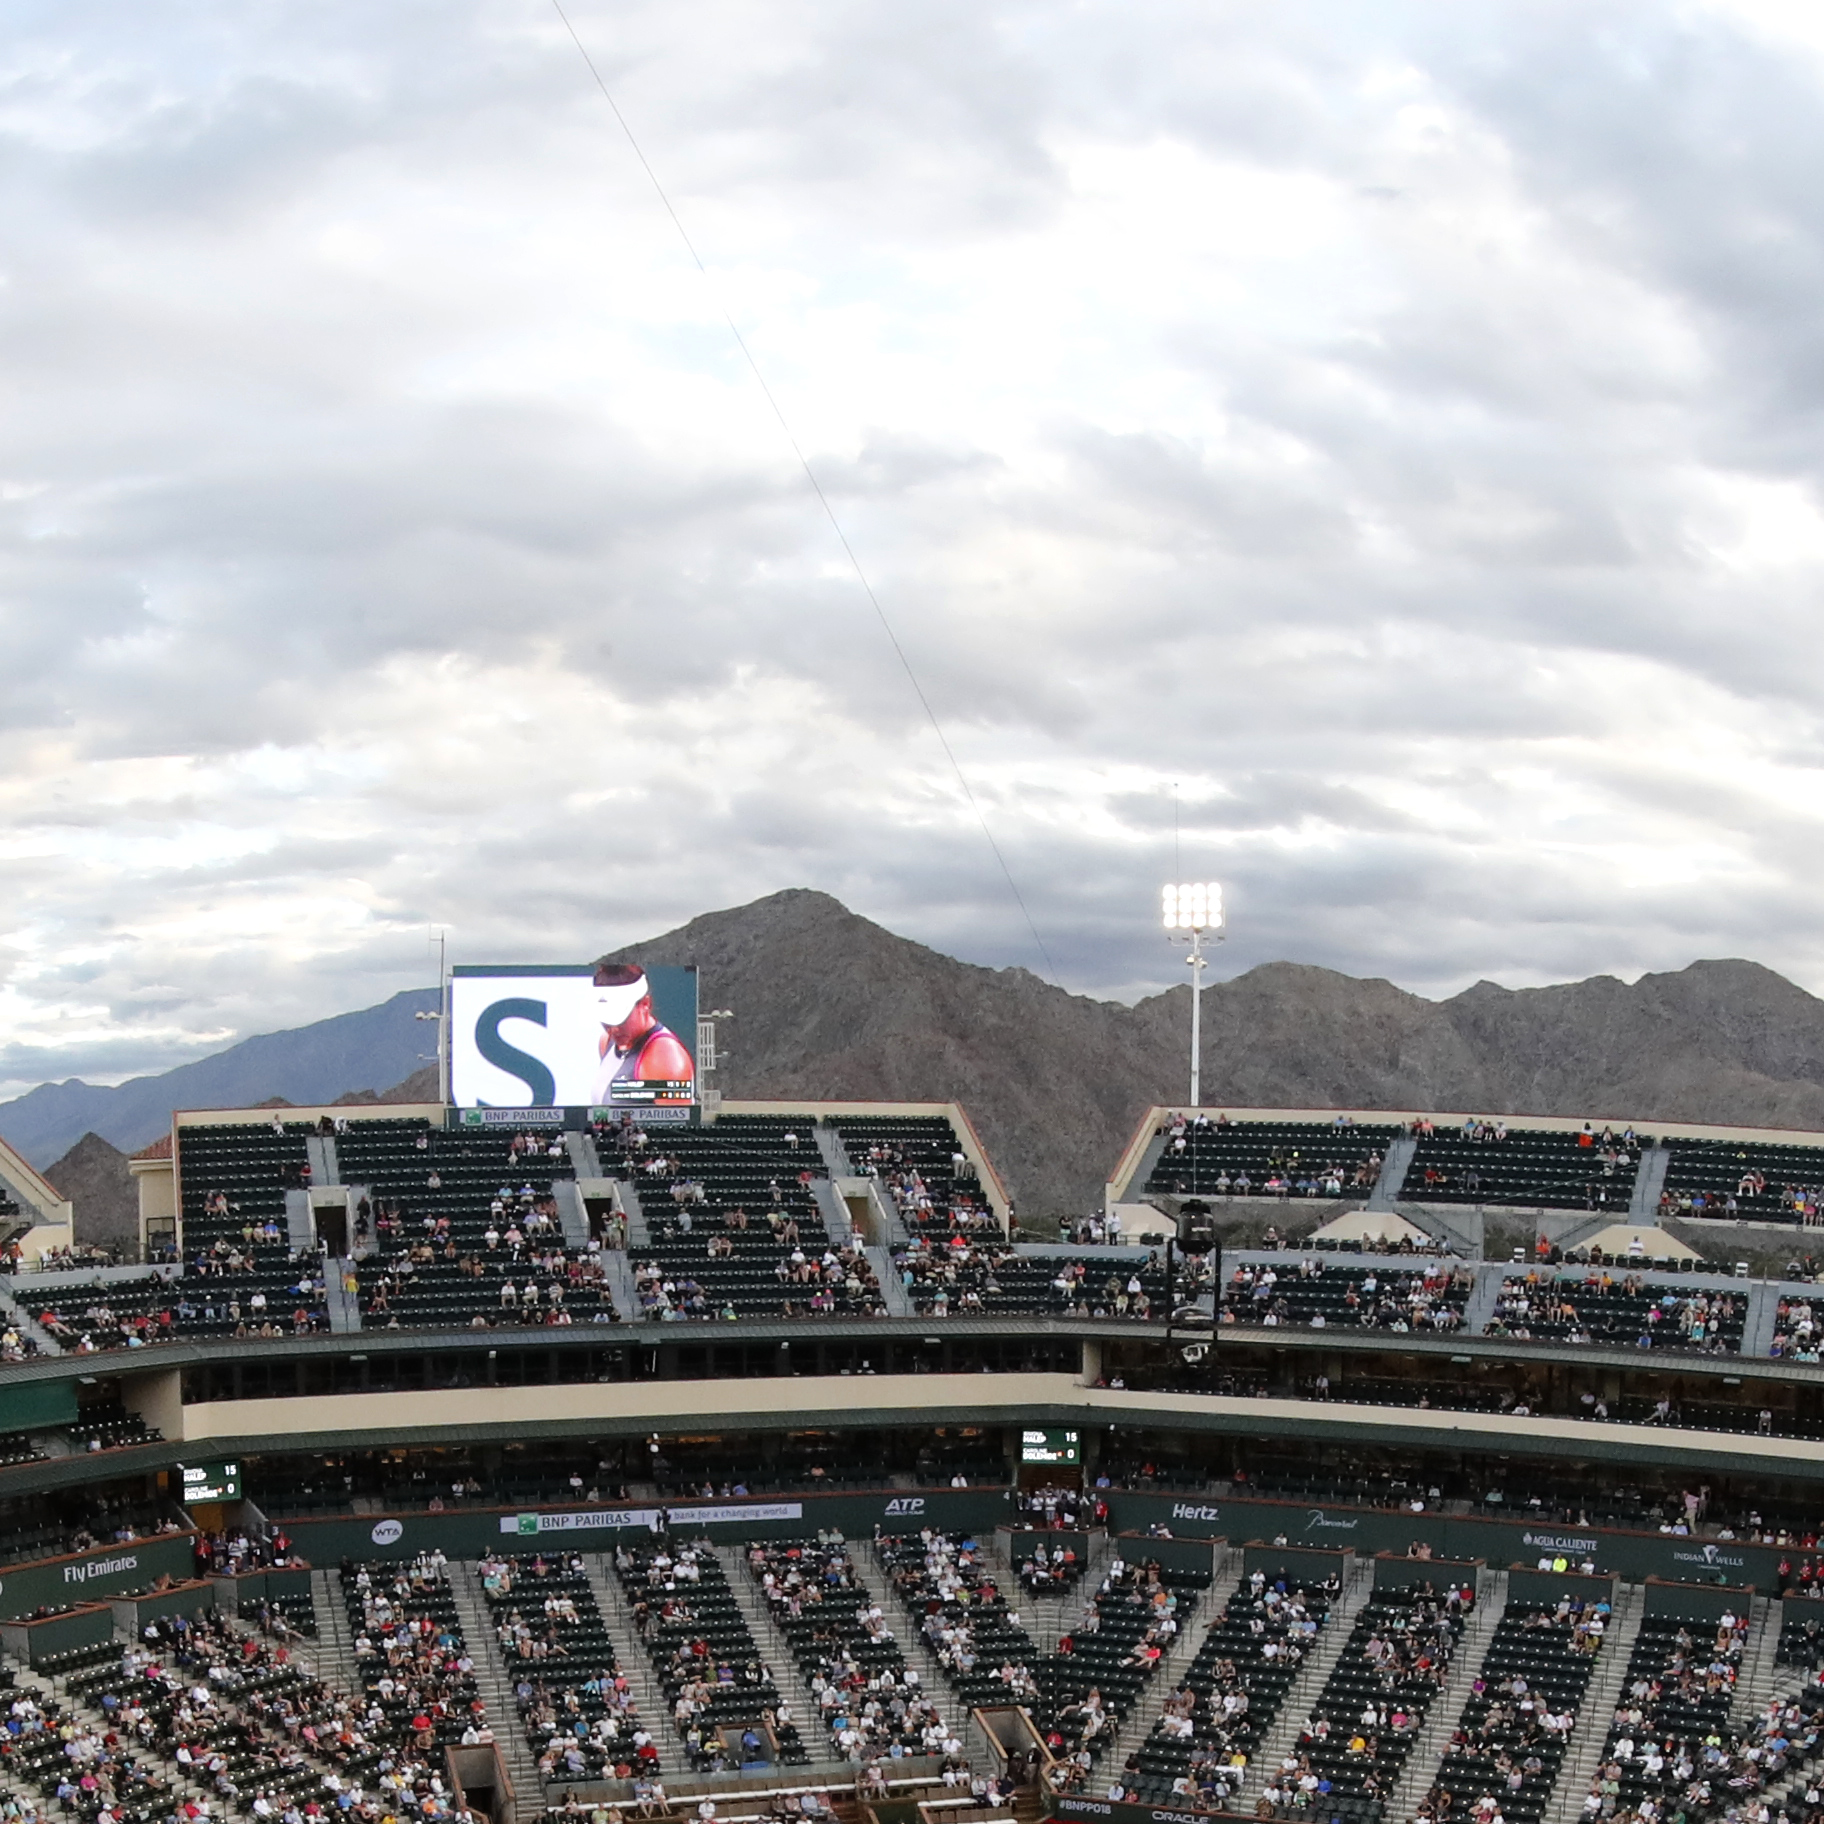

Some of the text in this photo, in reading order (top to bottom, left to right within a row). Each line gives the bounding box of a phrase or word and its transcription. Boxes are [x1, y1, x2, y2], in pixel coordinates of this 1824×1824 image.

[485, 1110, 560, 1121] BNP PARIBAS
[639, 1109, 686, 1119] PARIBAS
[1065, 1432, 1077, 1442] 15
[1067, 1449, 1075, 1459] 0
[225, 1465, 236, 1476] 15
[227, 1483, 235, 1494] 0
[885, 1498, 925, 1511] ATP
[1172, 1503, 1218, 1520] Hertz
[542, 1517, 569, 1528] BNP
[575, 1512, 631, 1527] PARIBAS
[674, 1511, 695, 1520] bank
[697, 1509, 710, 1521] for
[721, 1507, 760, 1520] changing
[763, 1507, 788, 1515] world
[375, 1527, 400, 1537] WTA
[1532, 1535, 1555, 1548] AGUA
[1555, 1537, 1598, 1551] CALIENTE
[1674, 1552, 1705, 1563] INDIAN
[1715, 1555, 1744, 1567] WELLS
[64, 1554, 138, 1583] Fly Emirates
